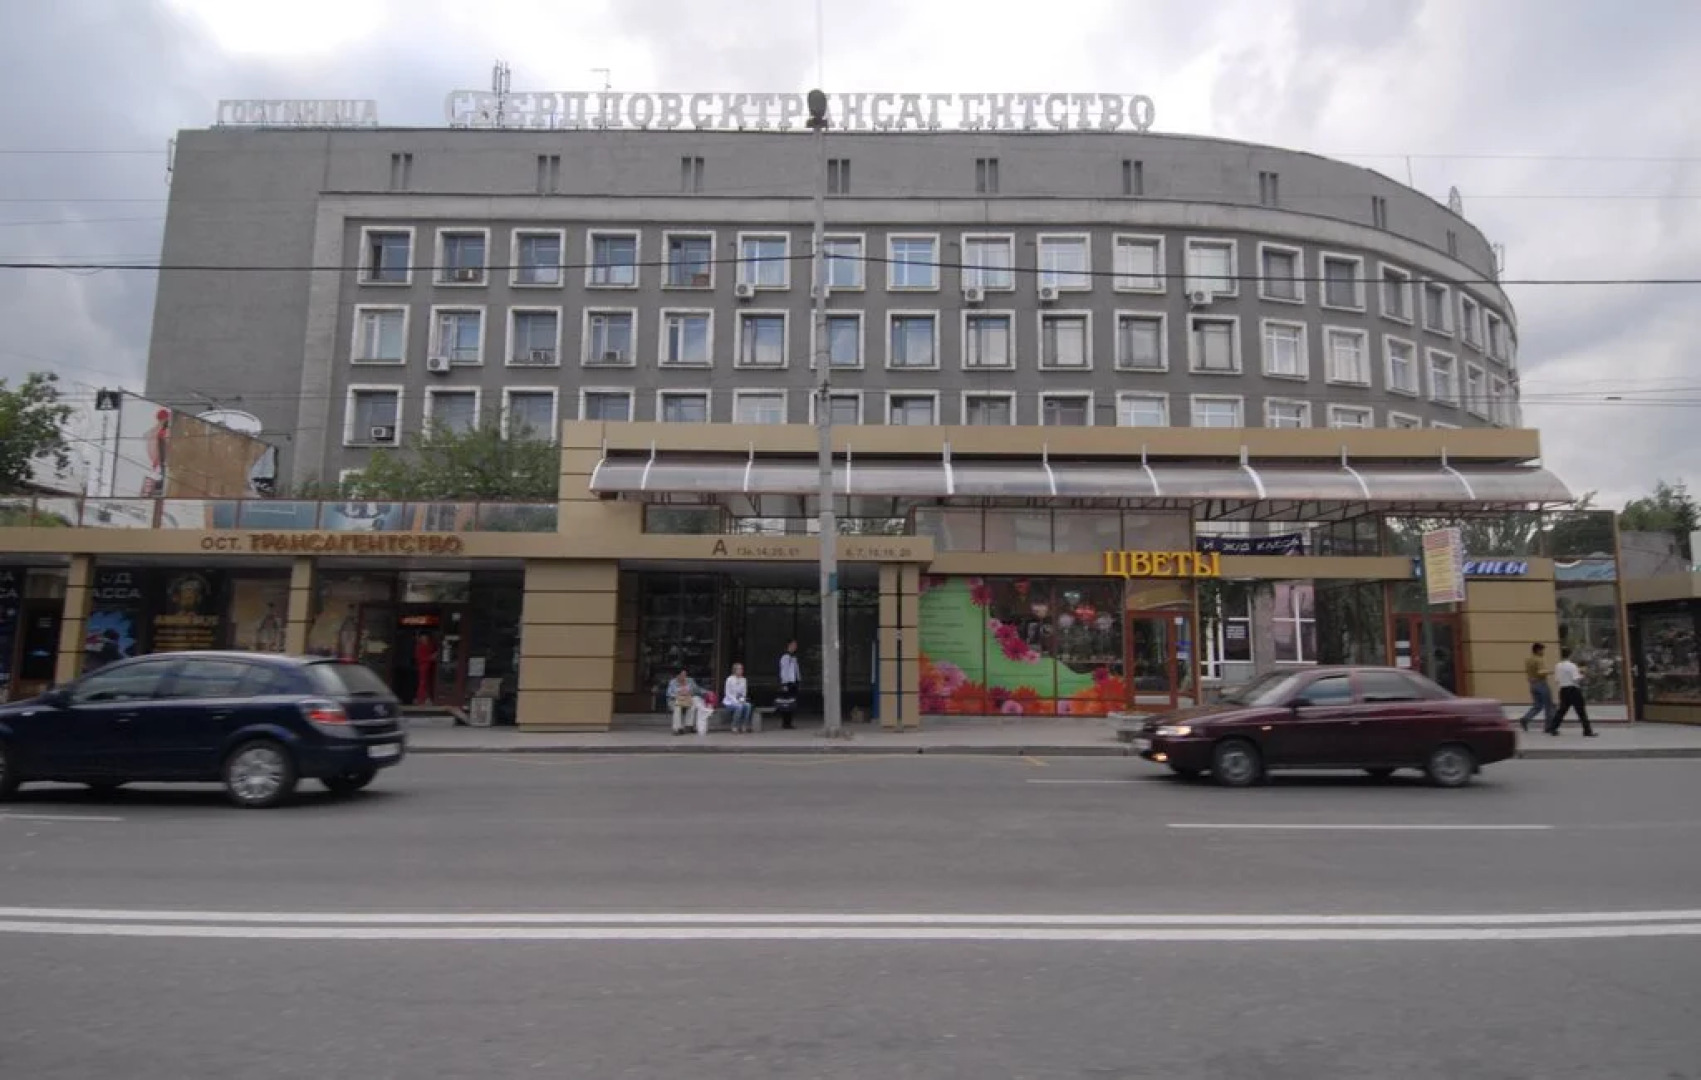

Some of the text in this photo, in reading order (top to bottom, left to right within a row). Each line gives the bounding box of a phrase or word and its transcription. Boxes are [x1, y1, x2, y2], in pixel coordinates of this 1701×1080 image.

[217, 100, 378, 125] ГОСТИНИЦА
[201, 533, 464, 554] ОСТ. ТРАНСАГЕНТСТВО
[711, 539, 728, 556] А
[1104, 551, 1221, 579] ЦВЕТЫ
